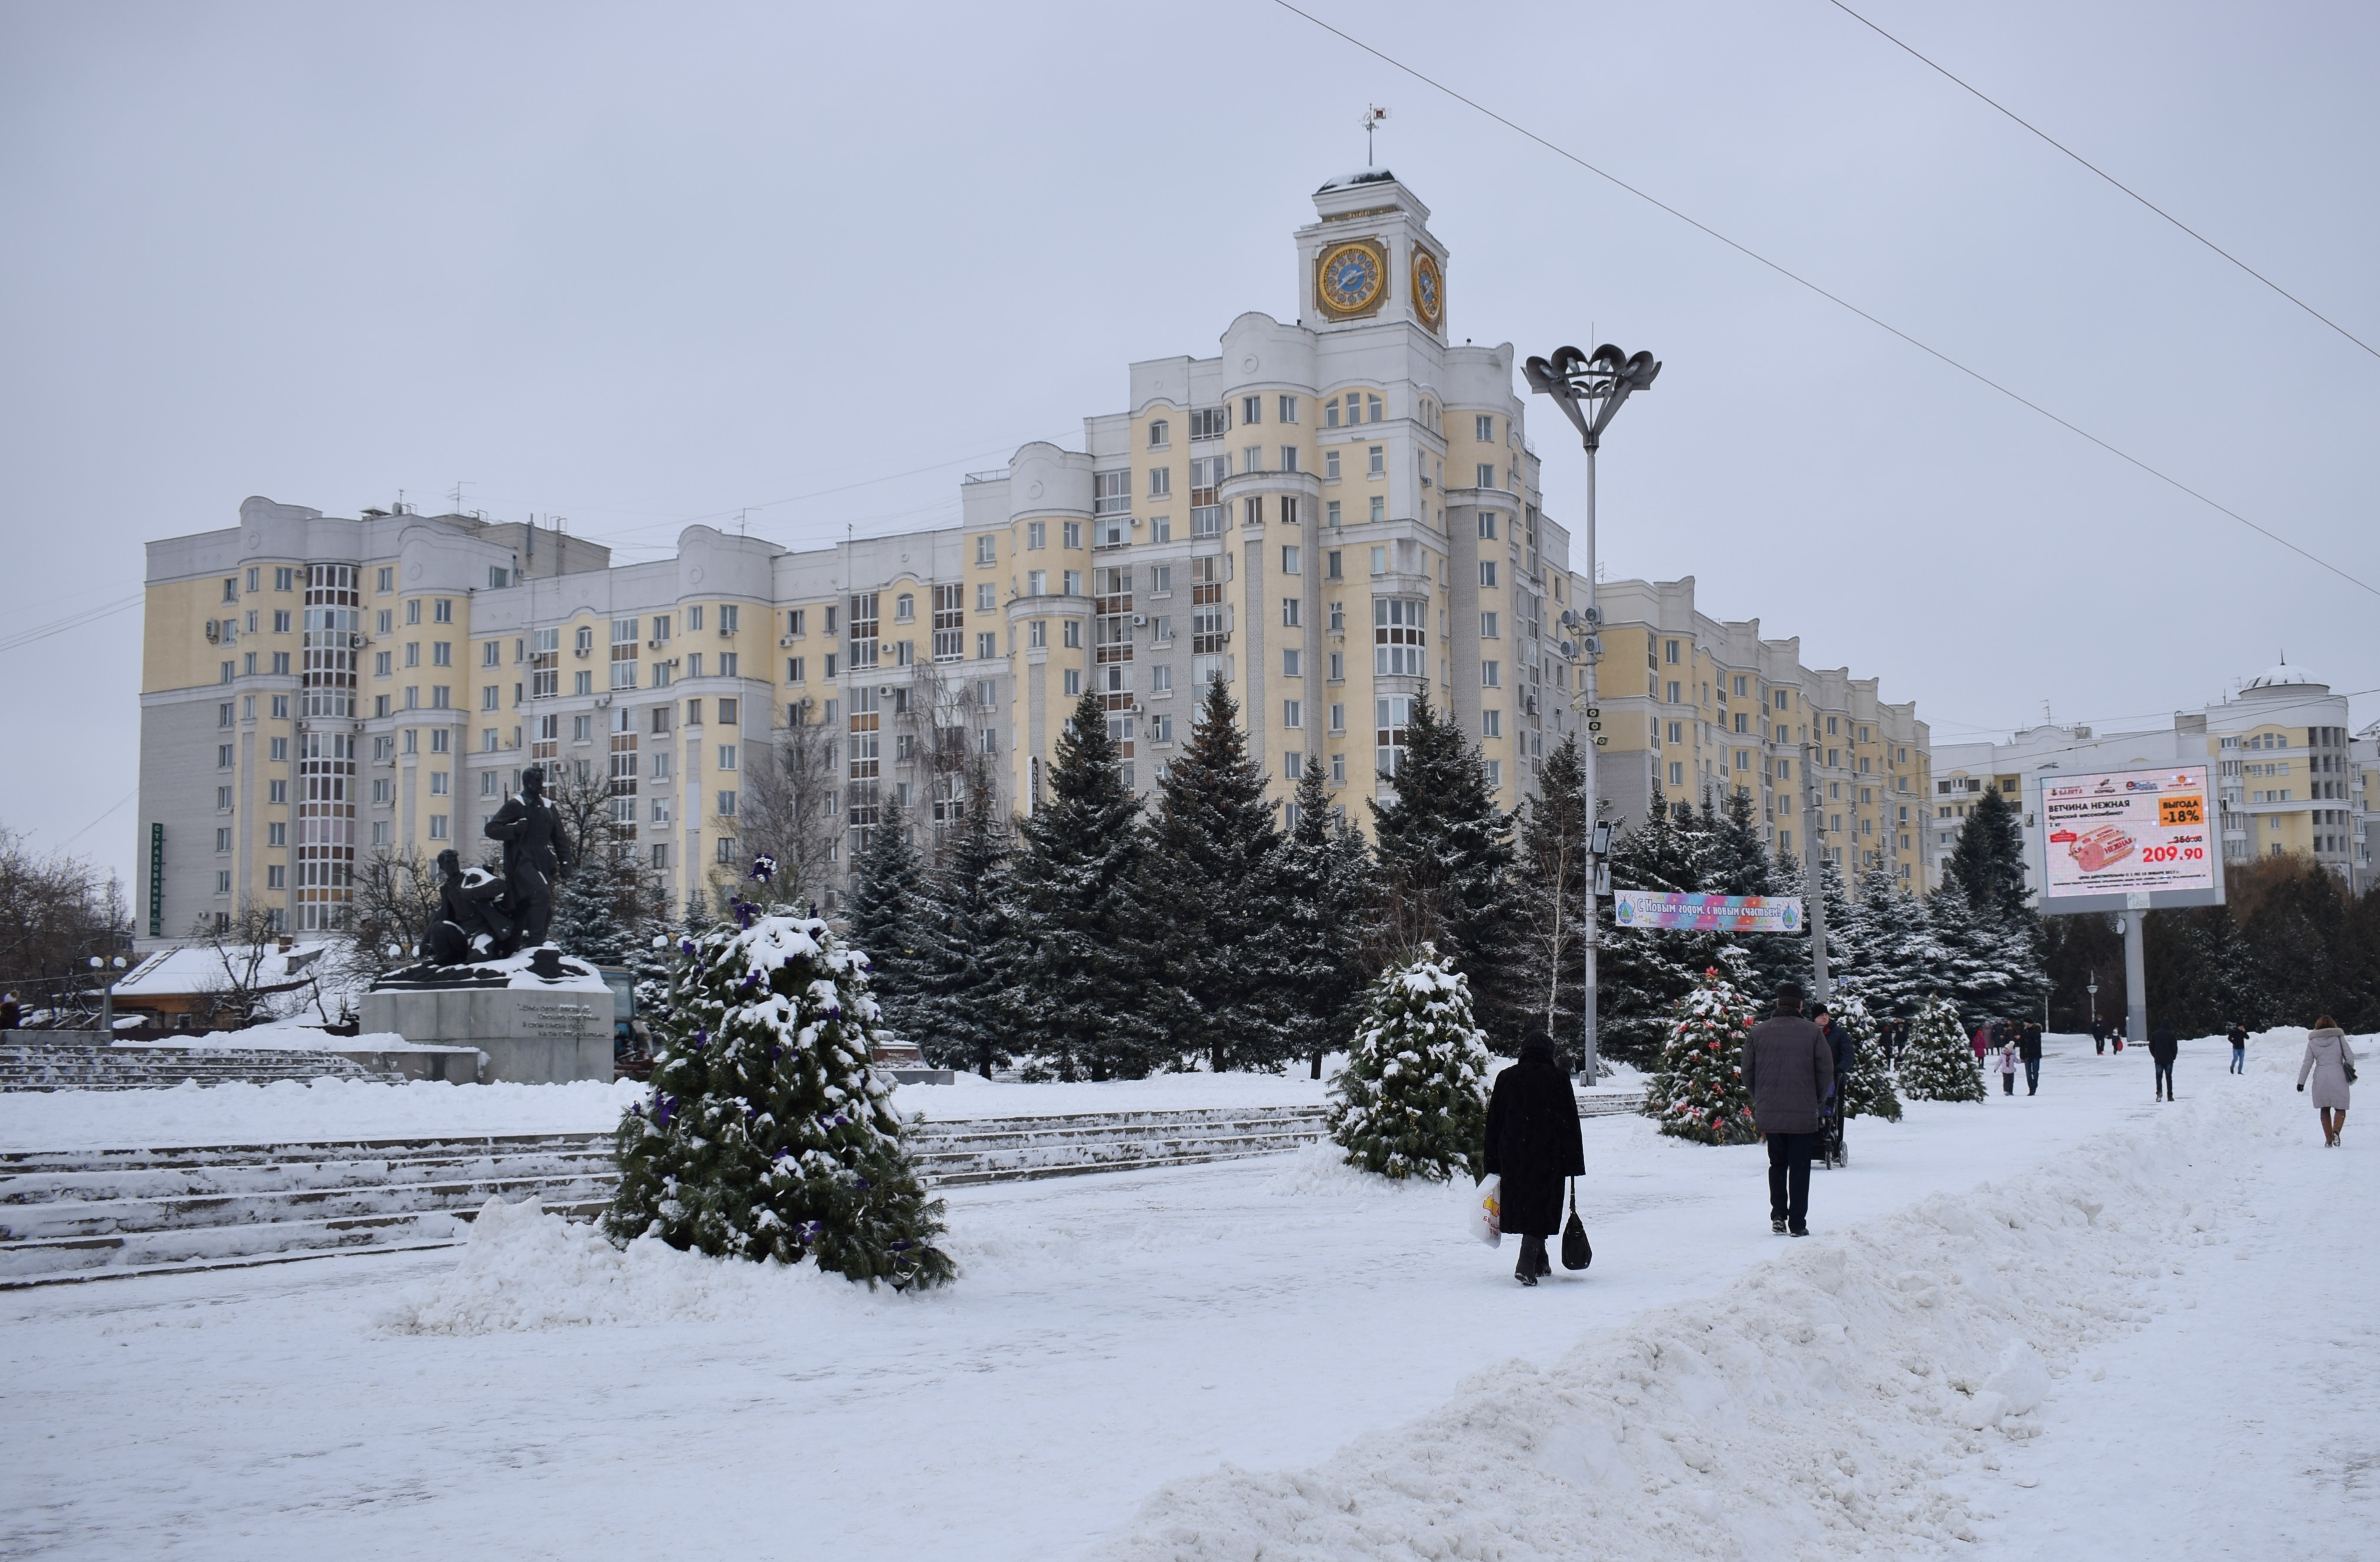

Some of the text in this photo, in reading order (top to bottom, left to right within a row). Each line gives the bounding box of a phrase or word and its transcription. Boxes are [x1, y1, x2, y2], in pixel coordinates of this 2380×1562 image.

[2048, 800, 2130, 813] ВЕТЧИНА НЕЖНАЯ
[2163, 801, 2198, 809] ВЫГОДА
[2163, 810, 2199, 823] -18%
[2104, 837, 2133, 854] НЕЖНАЯ
[2143, 846, 2203, 863] 209.90
[1636, 898, 1781, 917] С Новым годом, с новым счастьем!
